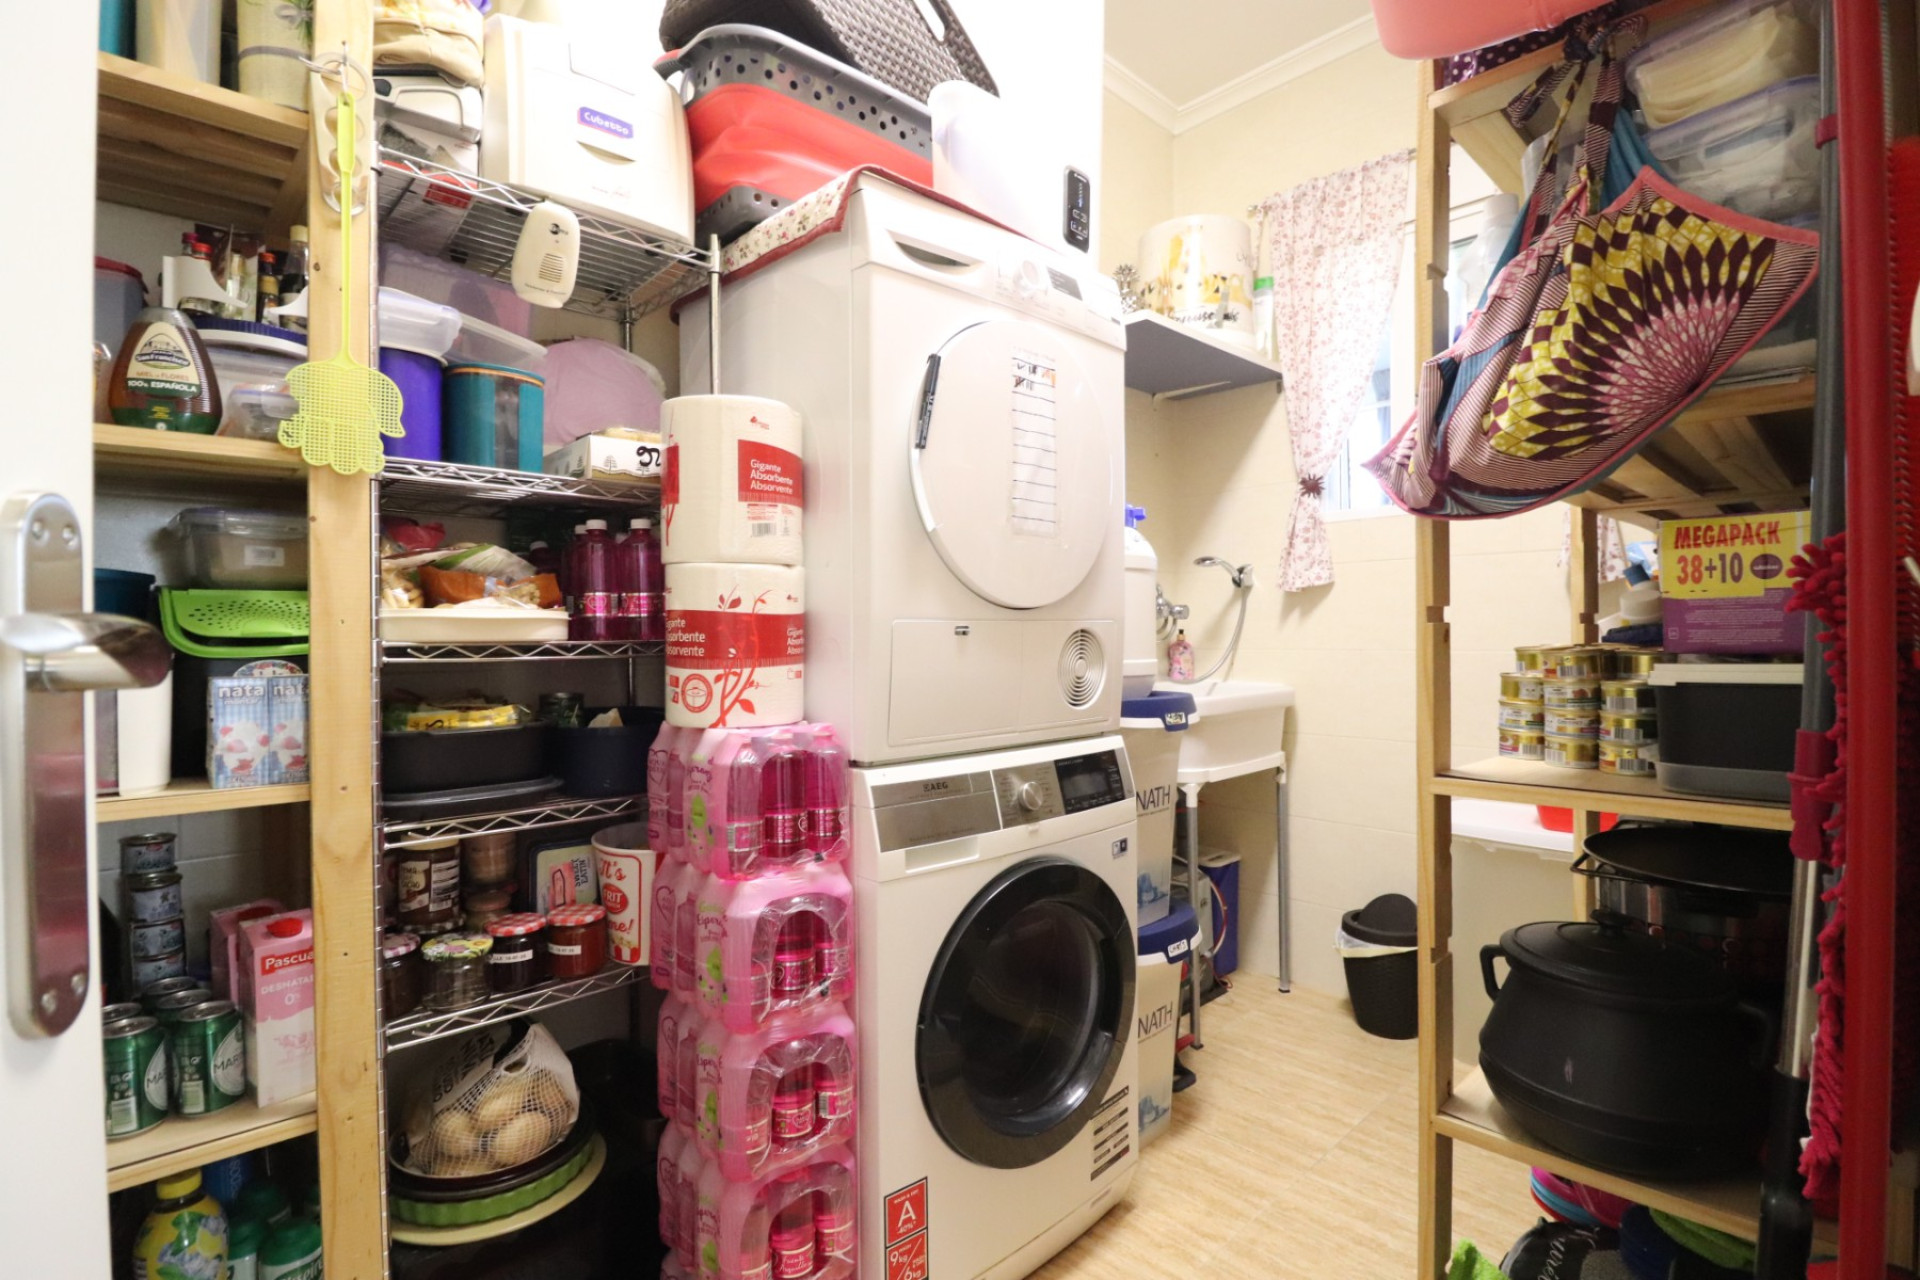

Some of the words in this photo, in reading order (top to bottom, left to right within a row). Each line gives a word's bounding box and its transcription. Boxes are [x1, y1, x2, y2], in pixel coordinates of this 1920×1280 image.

[150, 381, 198, 393] ESPAÑOLA
[750, 459, 782, 473] Gigante
[750, 468, 794, 486] Absorbente
[750, 479, 794, 495] Absorvente
[1673, 520, 1782, 550] MEGAPACK
[218, 684, 264, 698] nata
[273, 682, 306, 697] nat
[930, 781, 949, 791] AEG
[1136, 784, 1171, 811] NATH
[265, 951, 313, 970] Pascua
[261, 974, 313, 994] DESNATA
[1138, 1001, 1173, 1038] NATH
[897, 1200, 917, 1228] A
